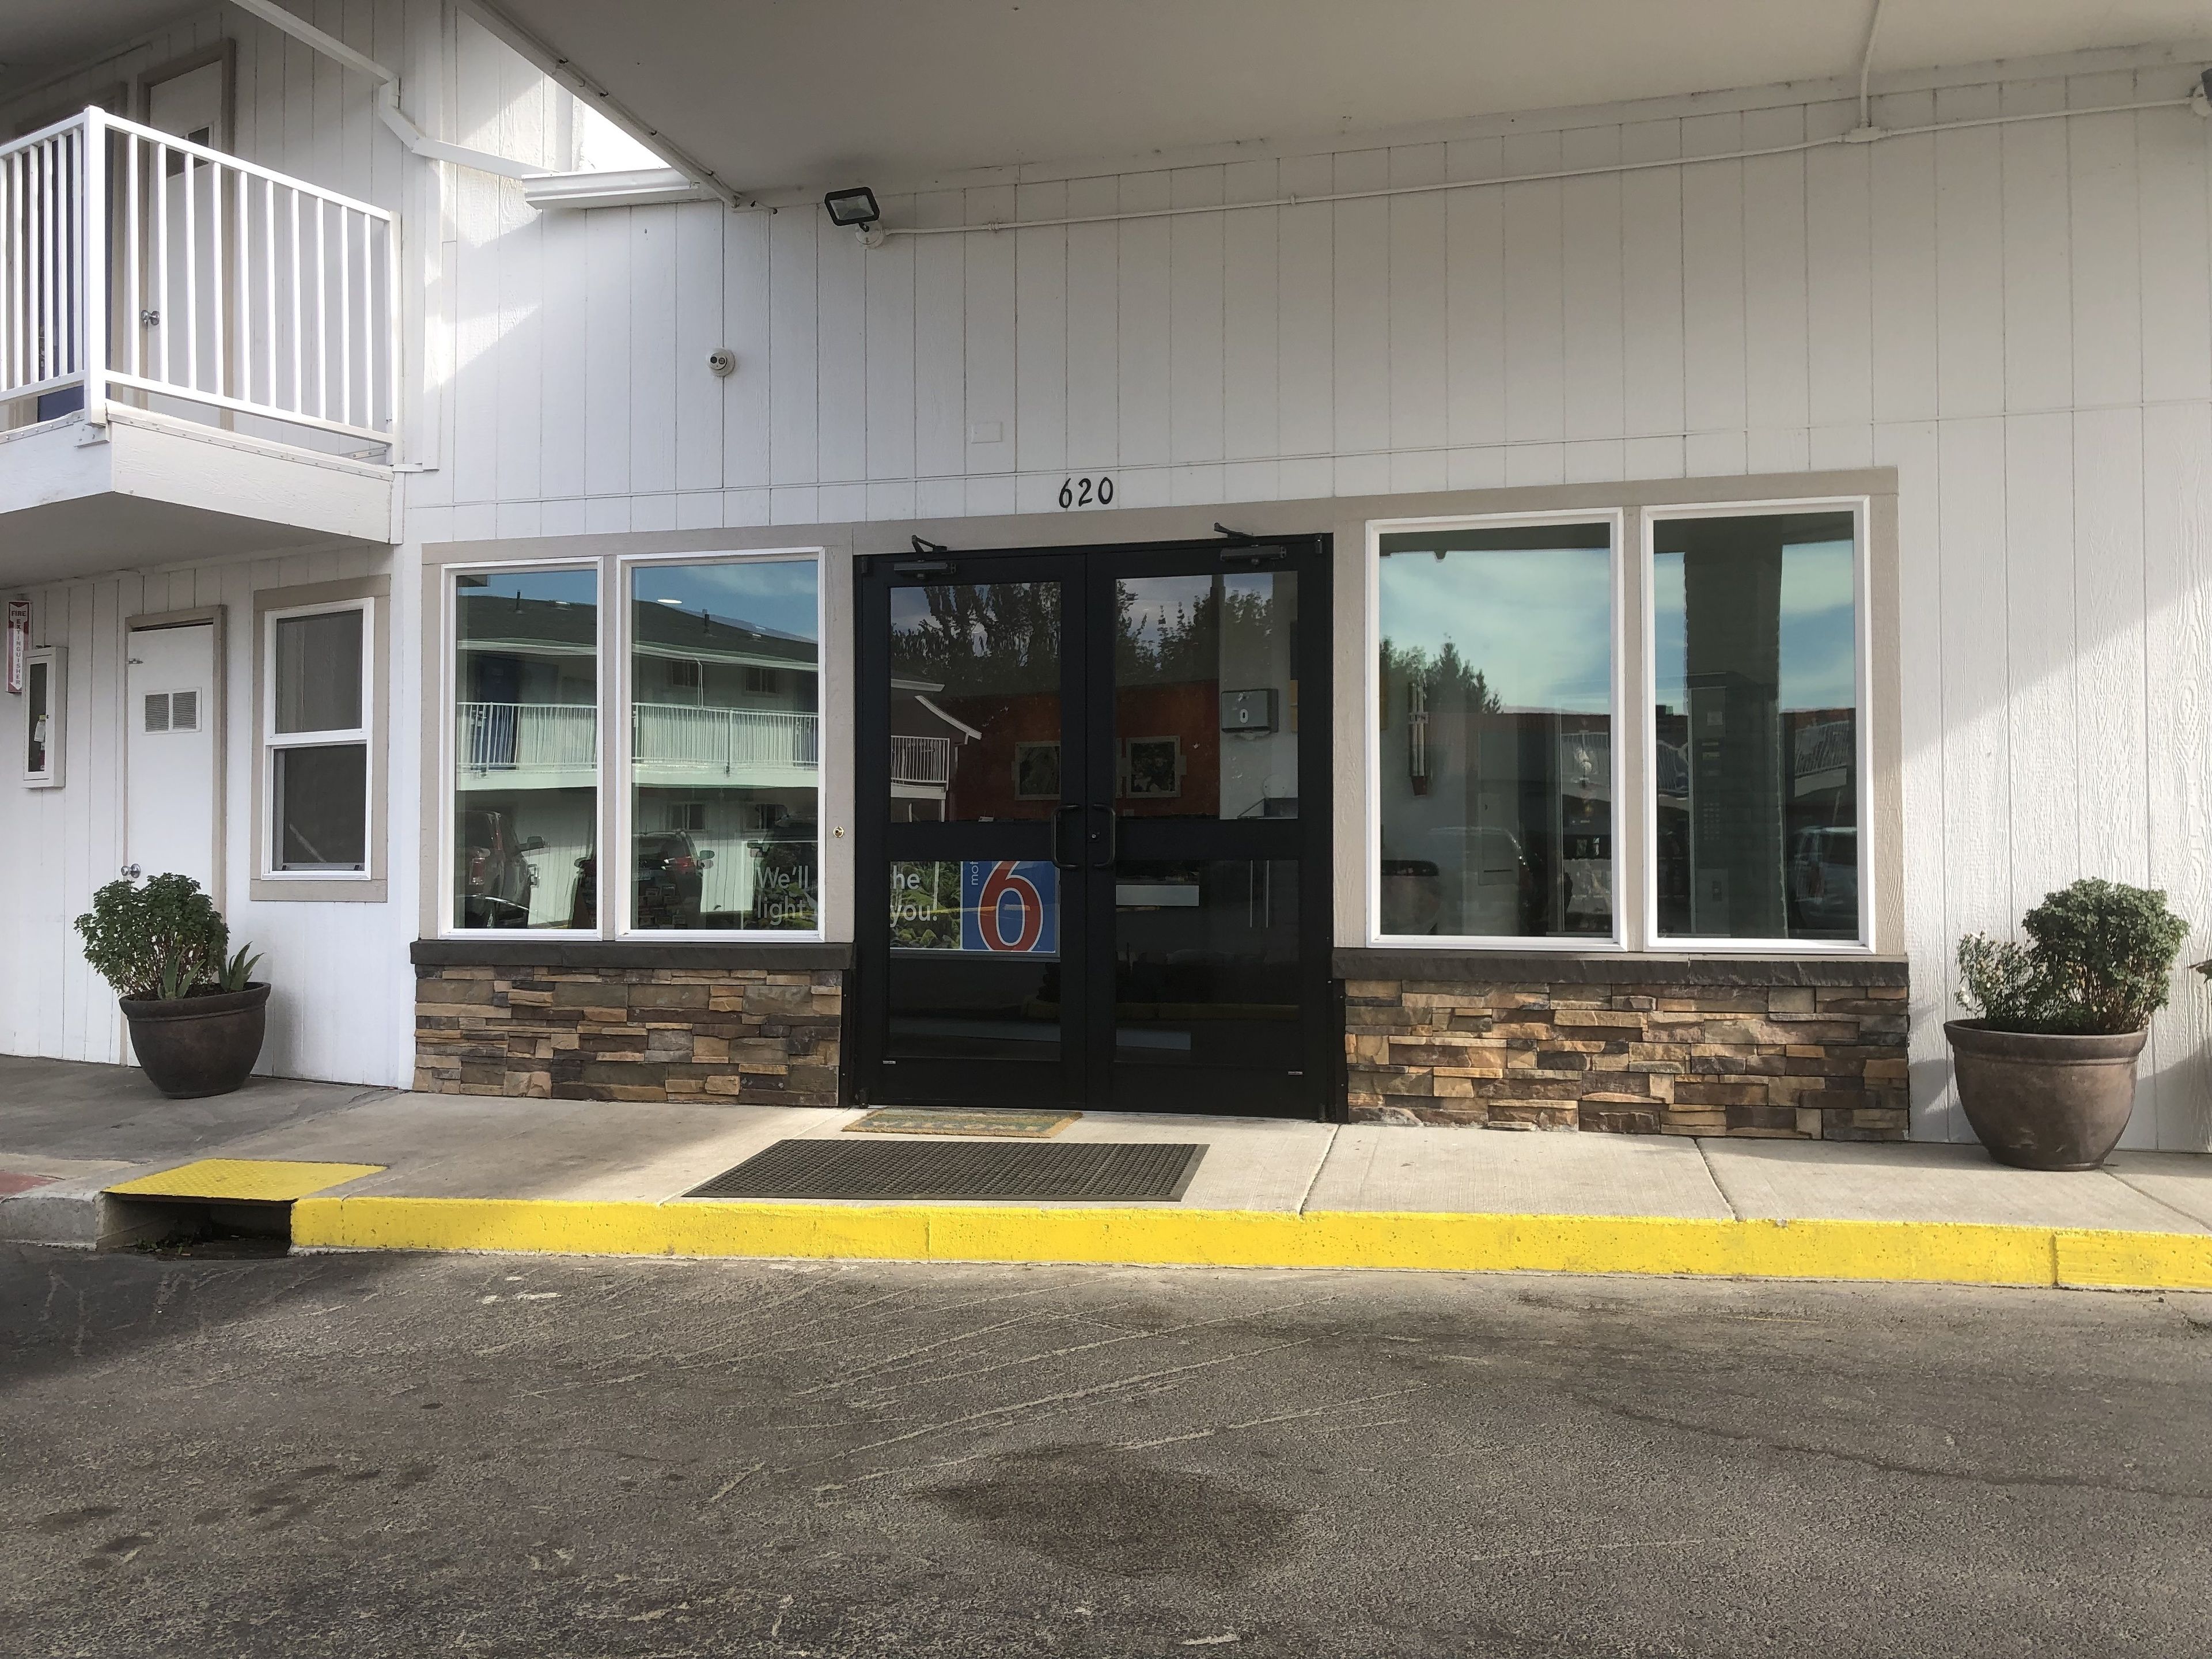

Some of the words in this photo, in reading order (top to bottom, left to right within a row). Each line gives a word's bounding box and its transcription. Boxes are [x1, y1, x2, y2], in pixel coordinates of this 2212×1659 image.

[1059, 476, 1113, 509] 620
[756, 865, 809, 889] We'll
[890, 865, 920, 890] he
[757, 895, 806, 926] light
[890, 904, 938, 928] you.
[978, 861, 1044, 952] 6
